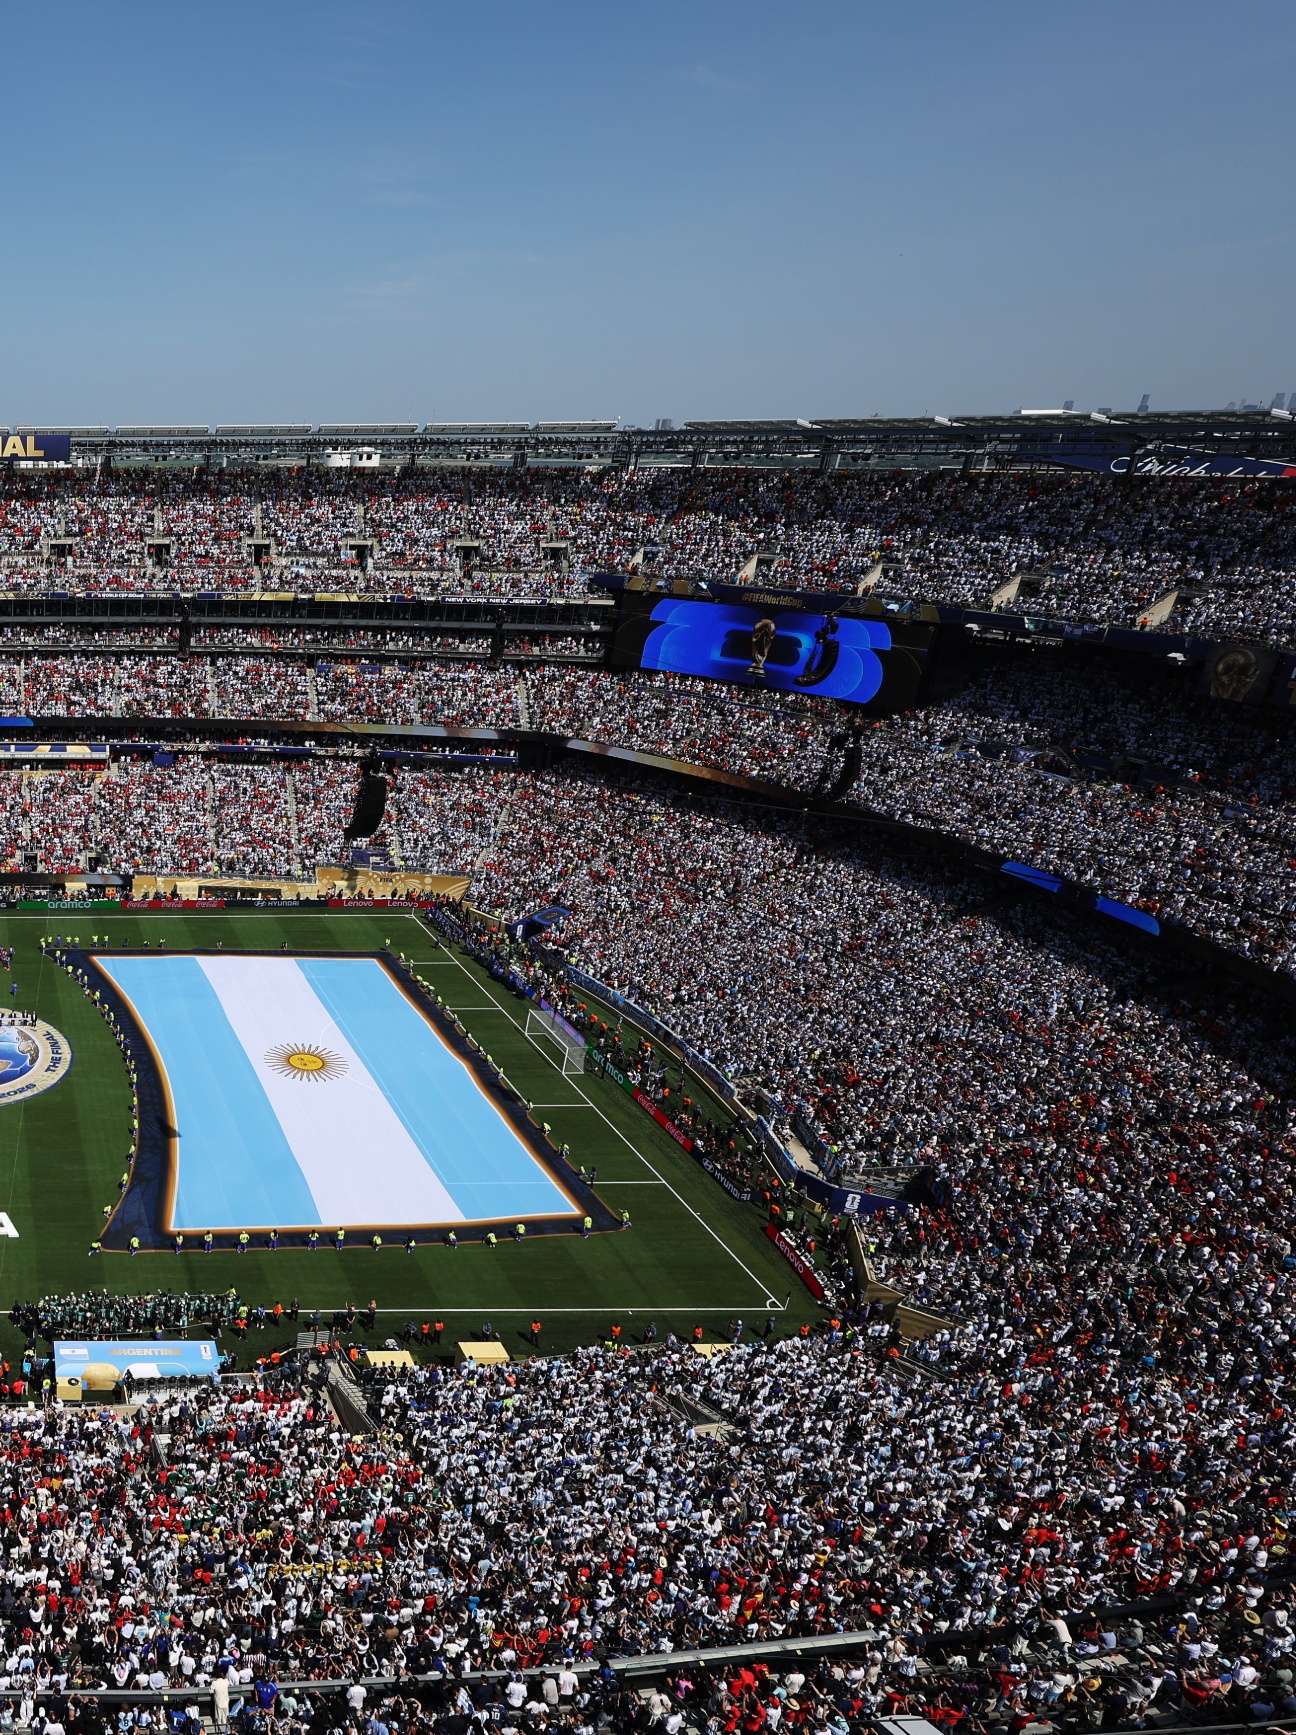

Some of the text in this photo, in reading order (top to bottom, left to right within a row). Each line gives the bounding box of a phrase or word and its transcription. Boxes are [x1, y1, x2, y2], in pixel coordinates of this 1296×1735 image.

[741, 592, 803, 608] #FIFAWorldCup
[47, 900, 92, 909] aramco
[387, 900, 419, 908] Lenovo
[45, 1030, 63, 1074] THE FINAL
[774, 1233, 804, 1274] Lenovo
[109, 1348, 183, 1356] ARGENTINA
[491, 1711, 501, 1720] 10
